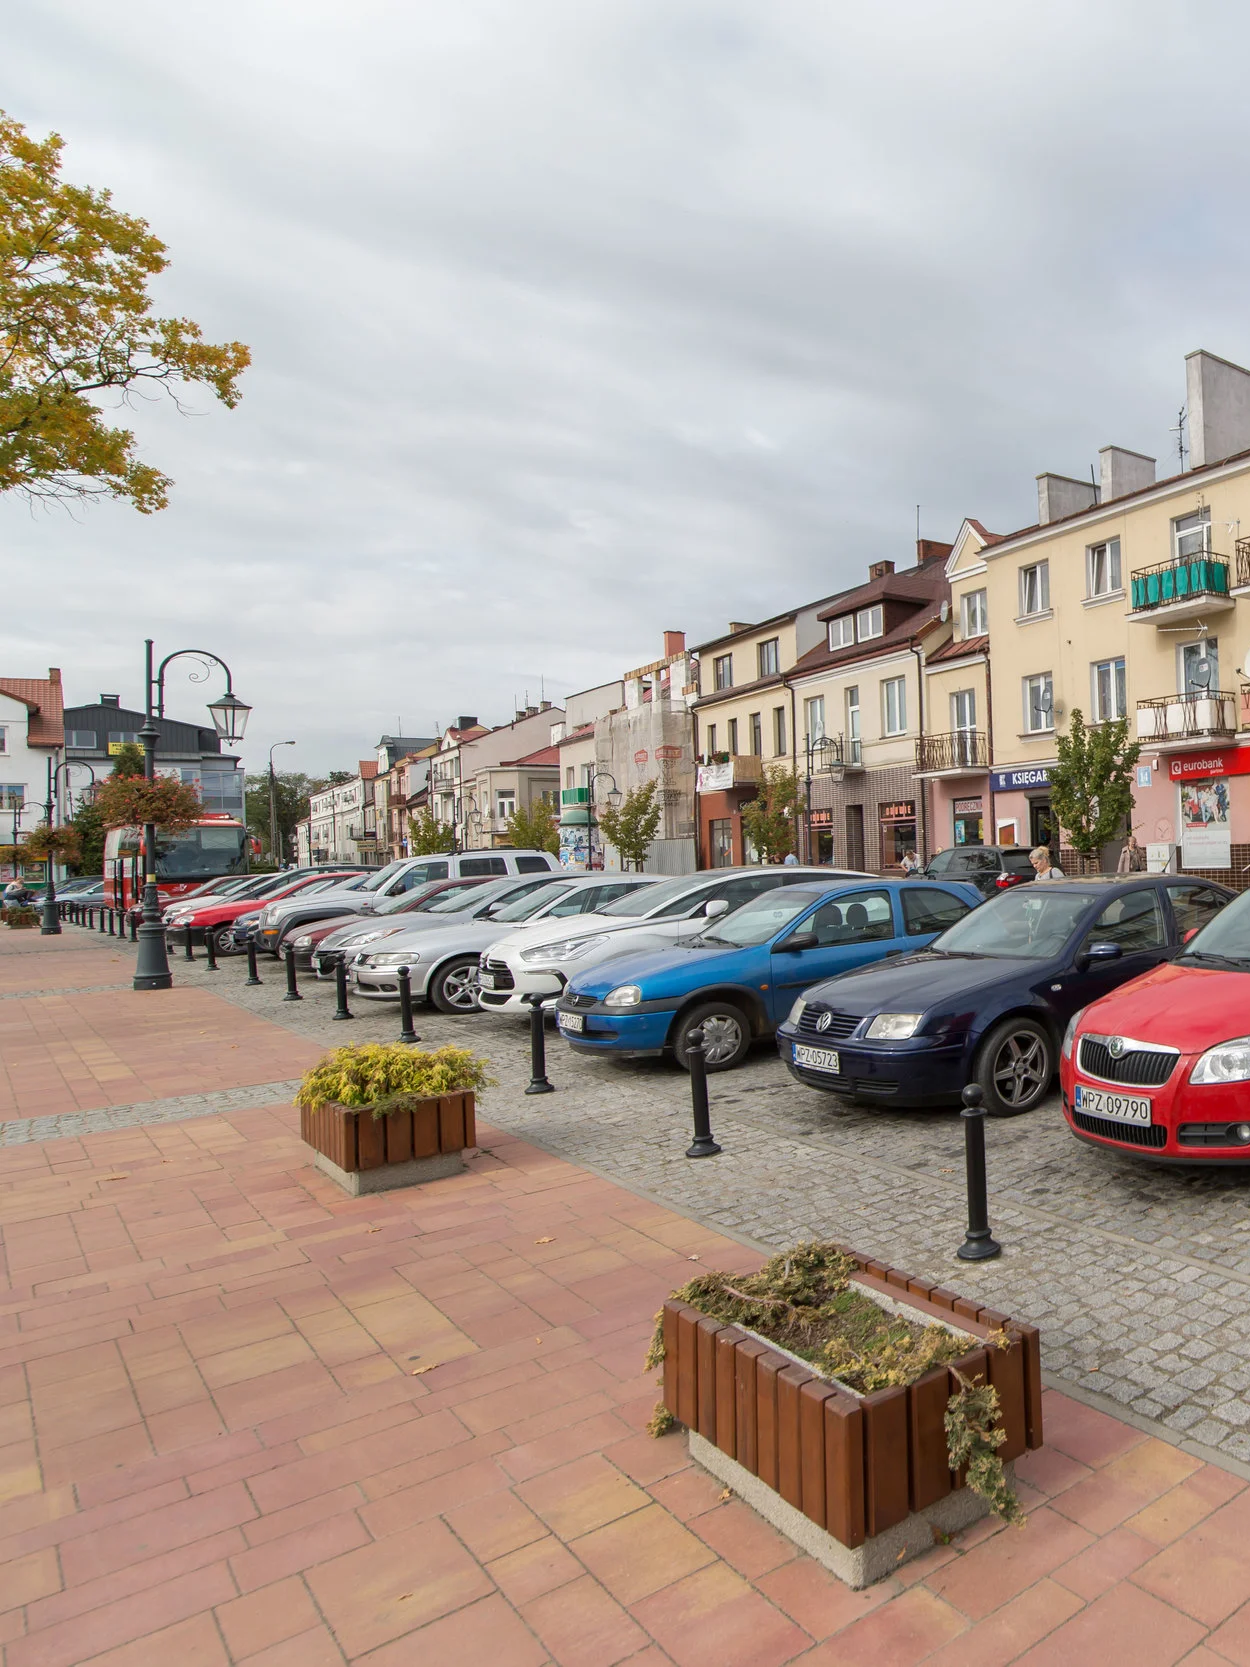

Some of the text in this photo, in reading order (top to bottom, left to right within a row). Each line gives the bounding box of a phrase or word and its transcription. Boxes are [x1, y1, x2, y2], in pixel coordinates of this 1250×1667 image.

[1183, 757, 1224, 772] eurobank
[1082, 1090, 1148, 1120] WPZ 09790
